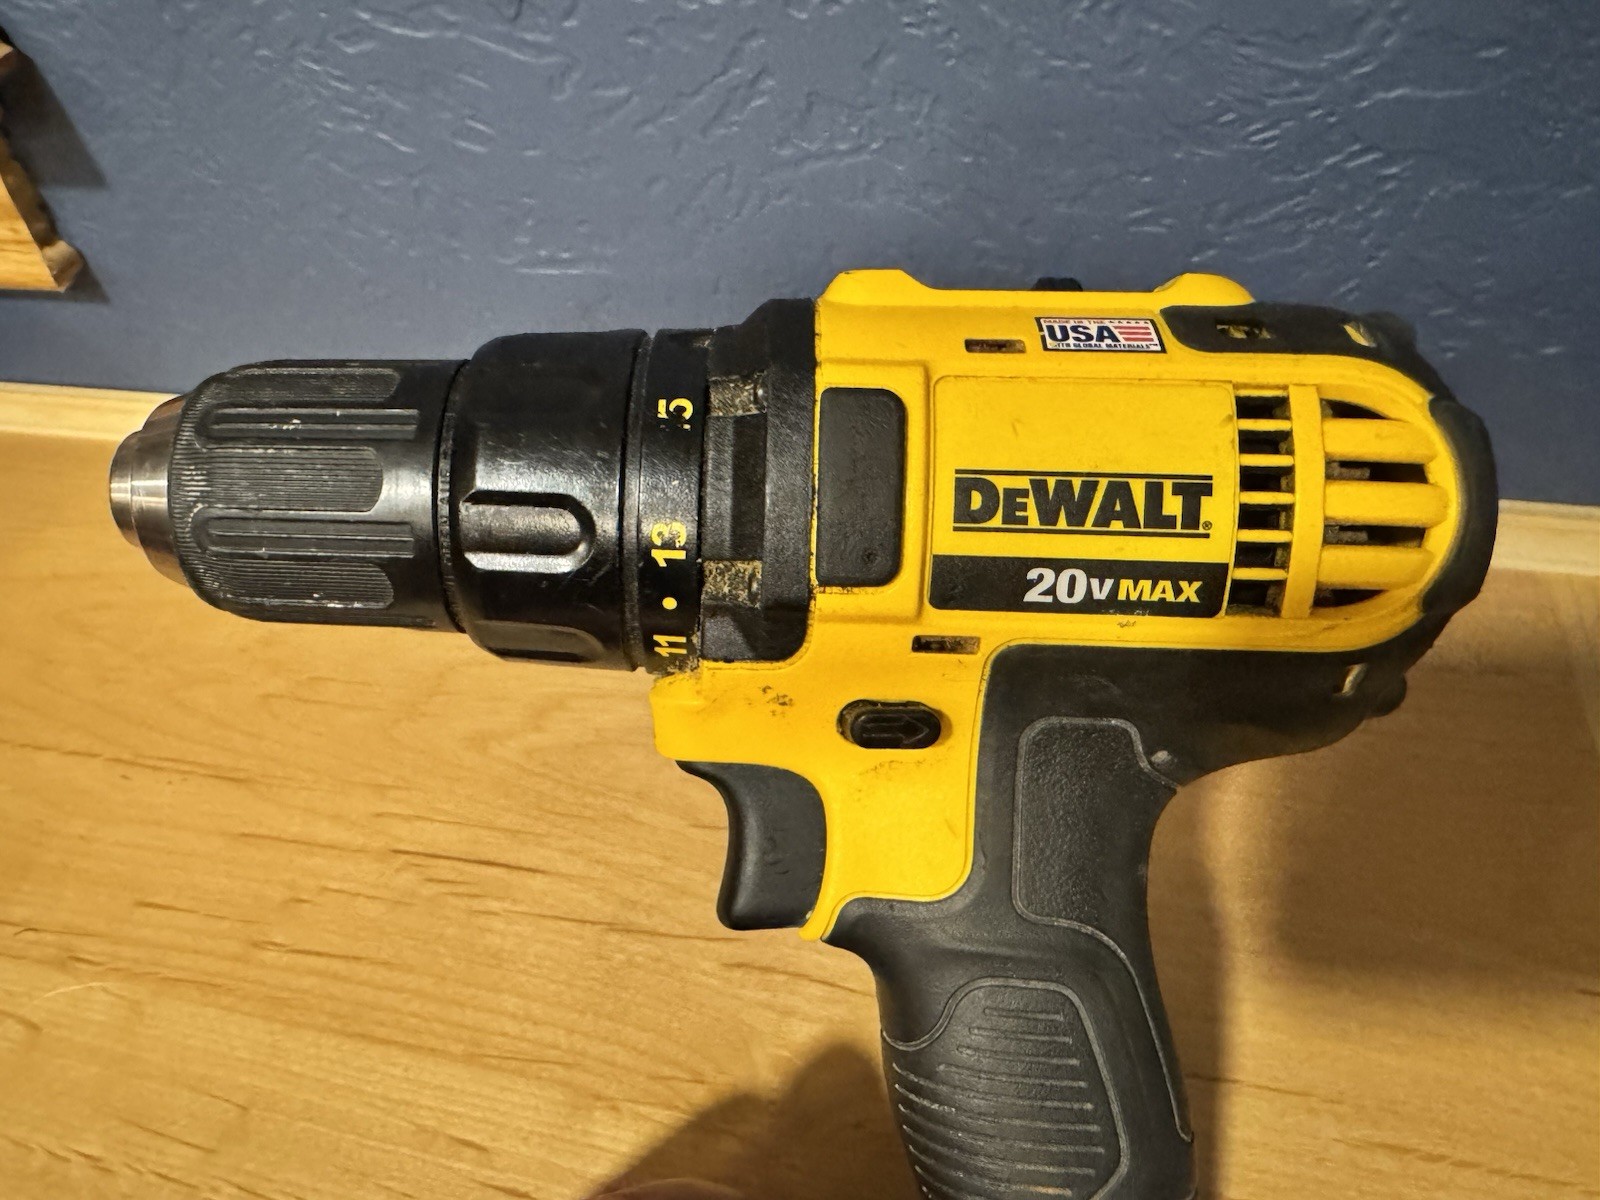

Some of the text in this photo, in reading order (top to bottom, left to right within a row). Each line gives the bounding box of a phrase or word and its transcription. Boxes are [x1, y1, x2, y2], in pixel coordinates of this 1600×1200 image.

[1045, 325, 1121, 342] USA
[651, 521, 687, 567] 13
[1117, 578, 1202, 603] MAX
[653, 634, 687, 657] 11
